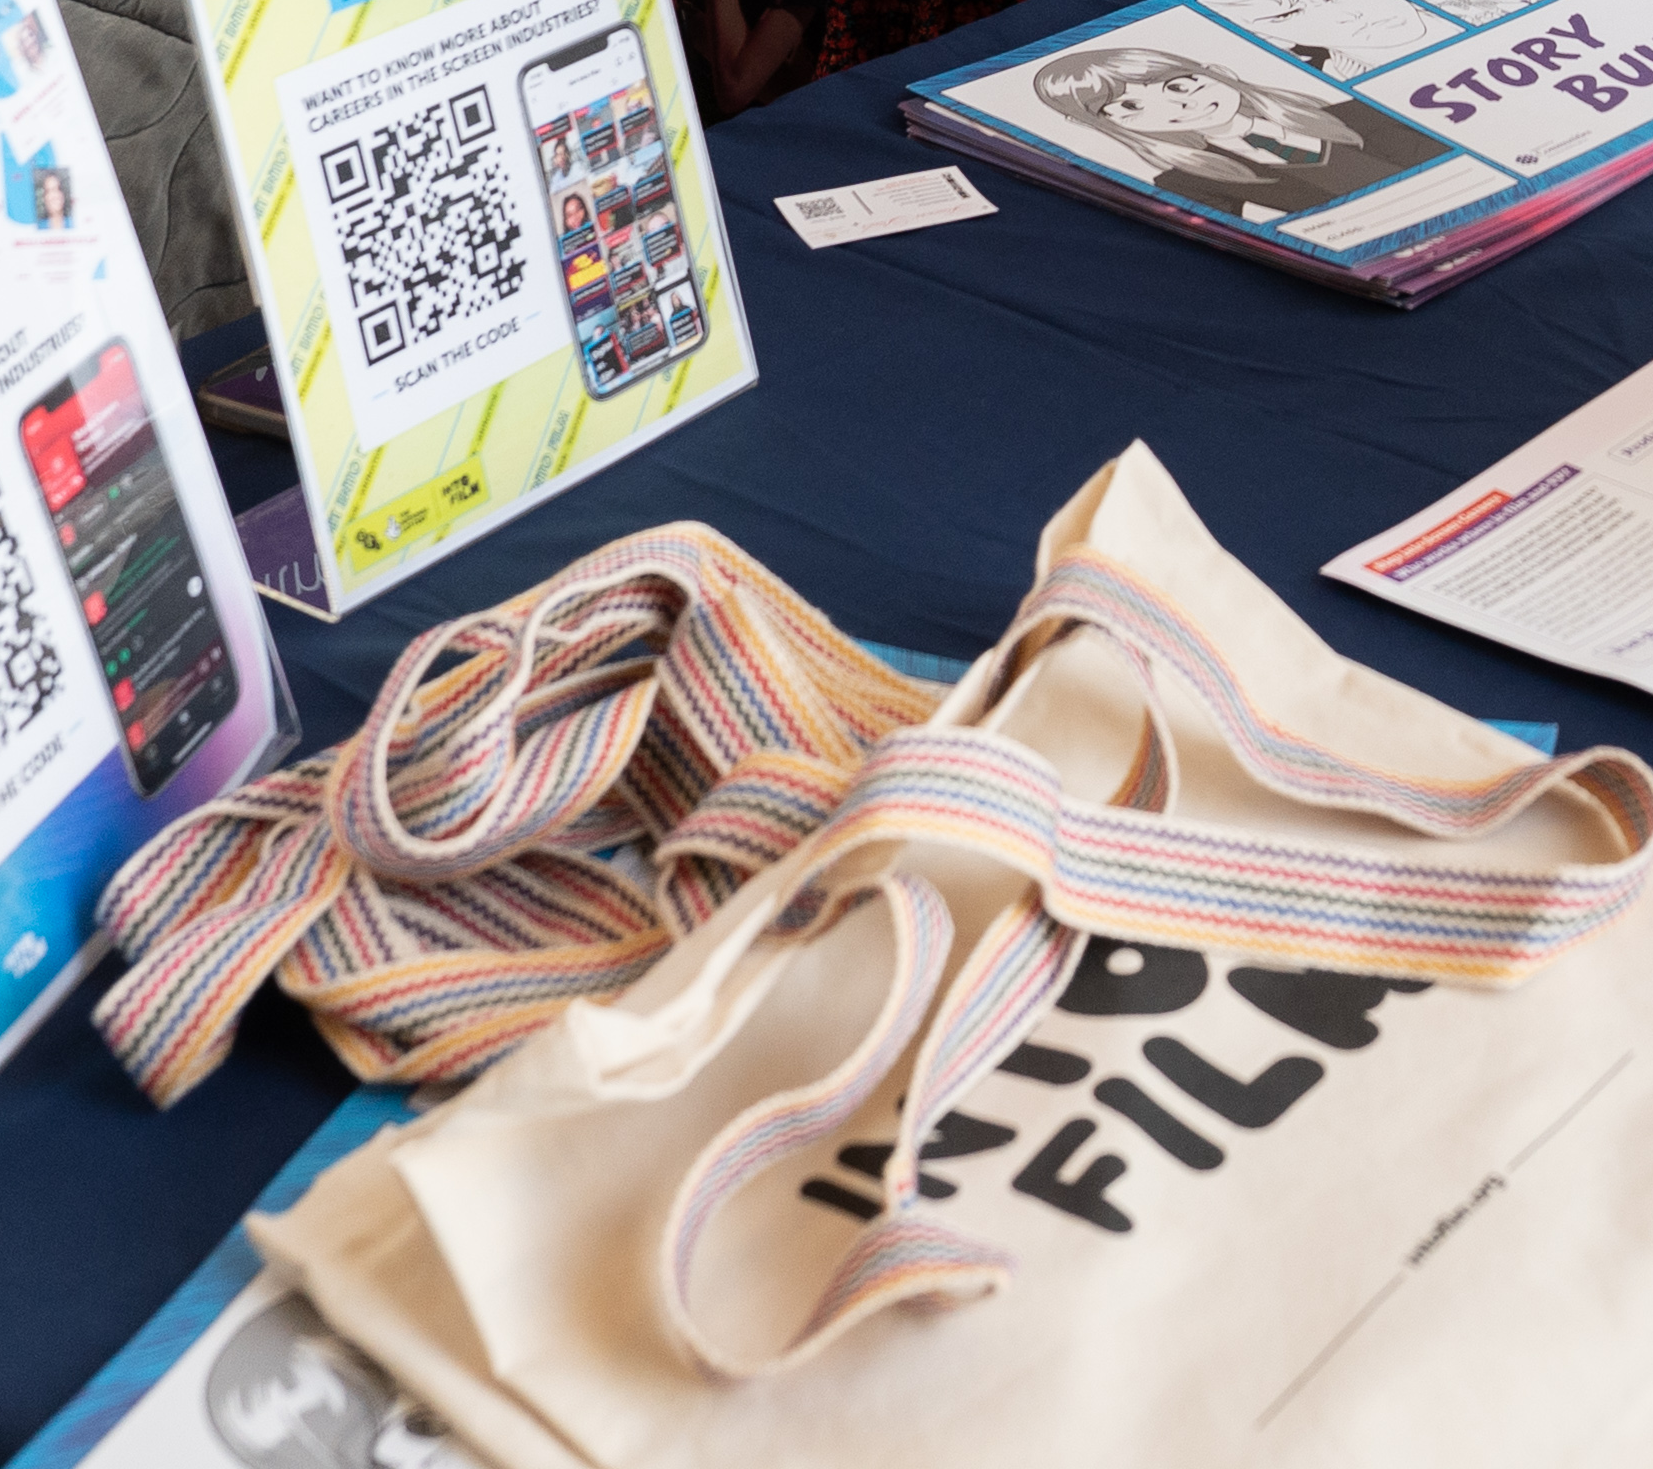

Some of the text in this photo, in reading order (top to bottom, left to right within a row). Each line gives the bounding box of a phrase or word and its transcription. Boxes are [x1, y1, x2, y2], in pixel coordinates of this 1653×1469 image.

[301, 0, 541, 111] WANT TO KNOW MORE ABOUT
[308, 89, 383, 133] CAREERS
[387, 82, 404, 100] IN
[407, 66, 438, 92] THE
[442, 42, 502, 77] SCREEN
[1408, 13, 1605, 124] STORY
[395, 317, 521, 394] SCAN THE CODE
